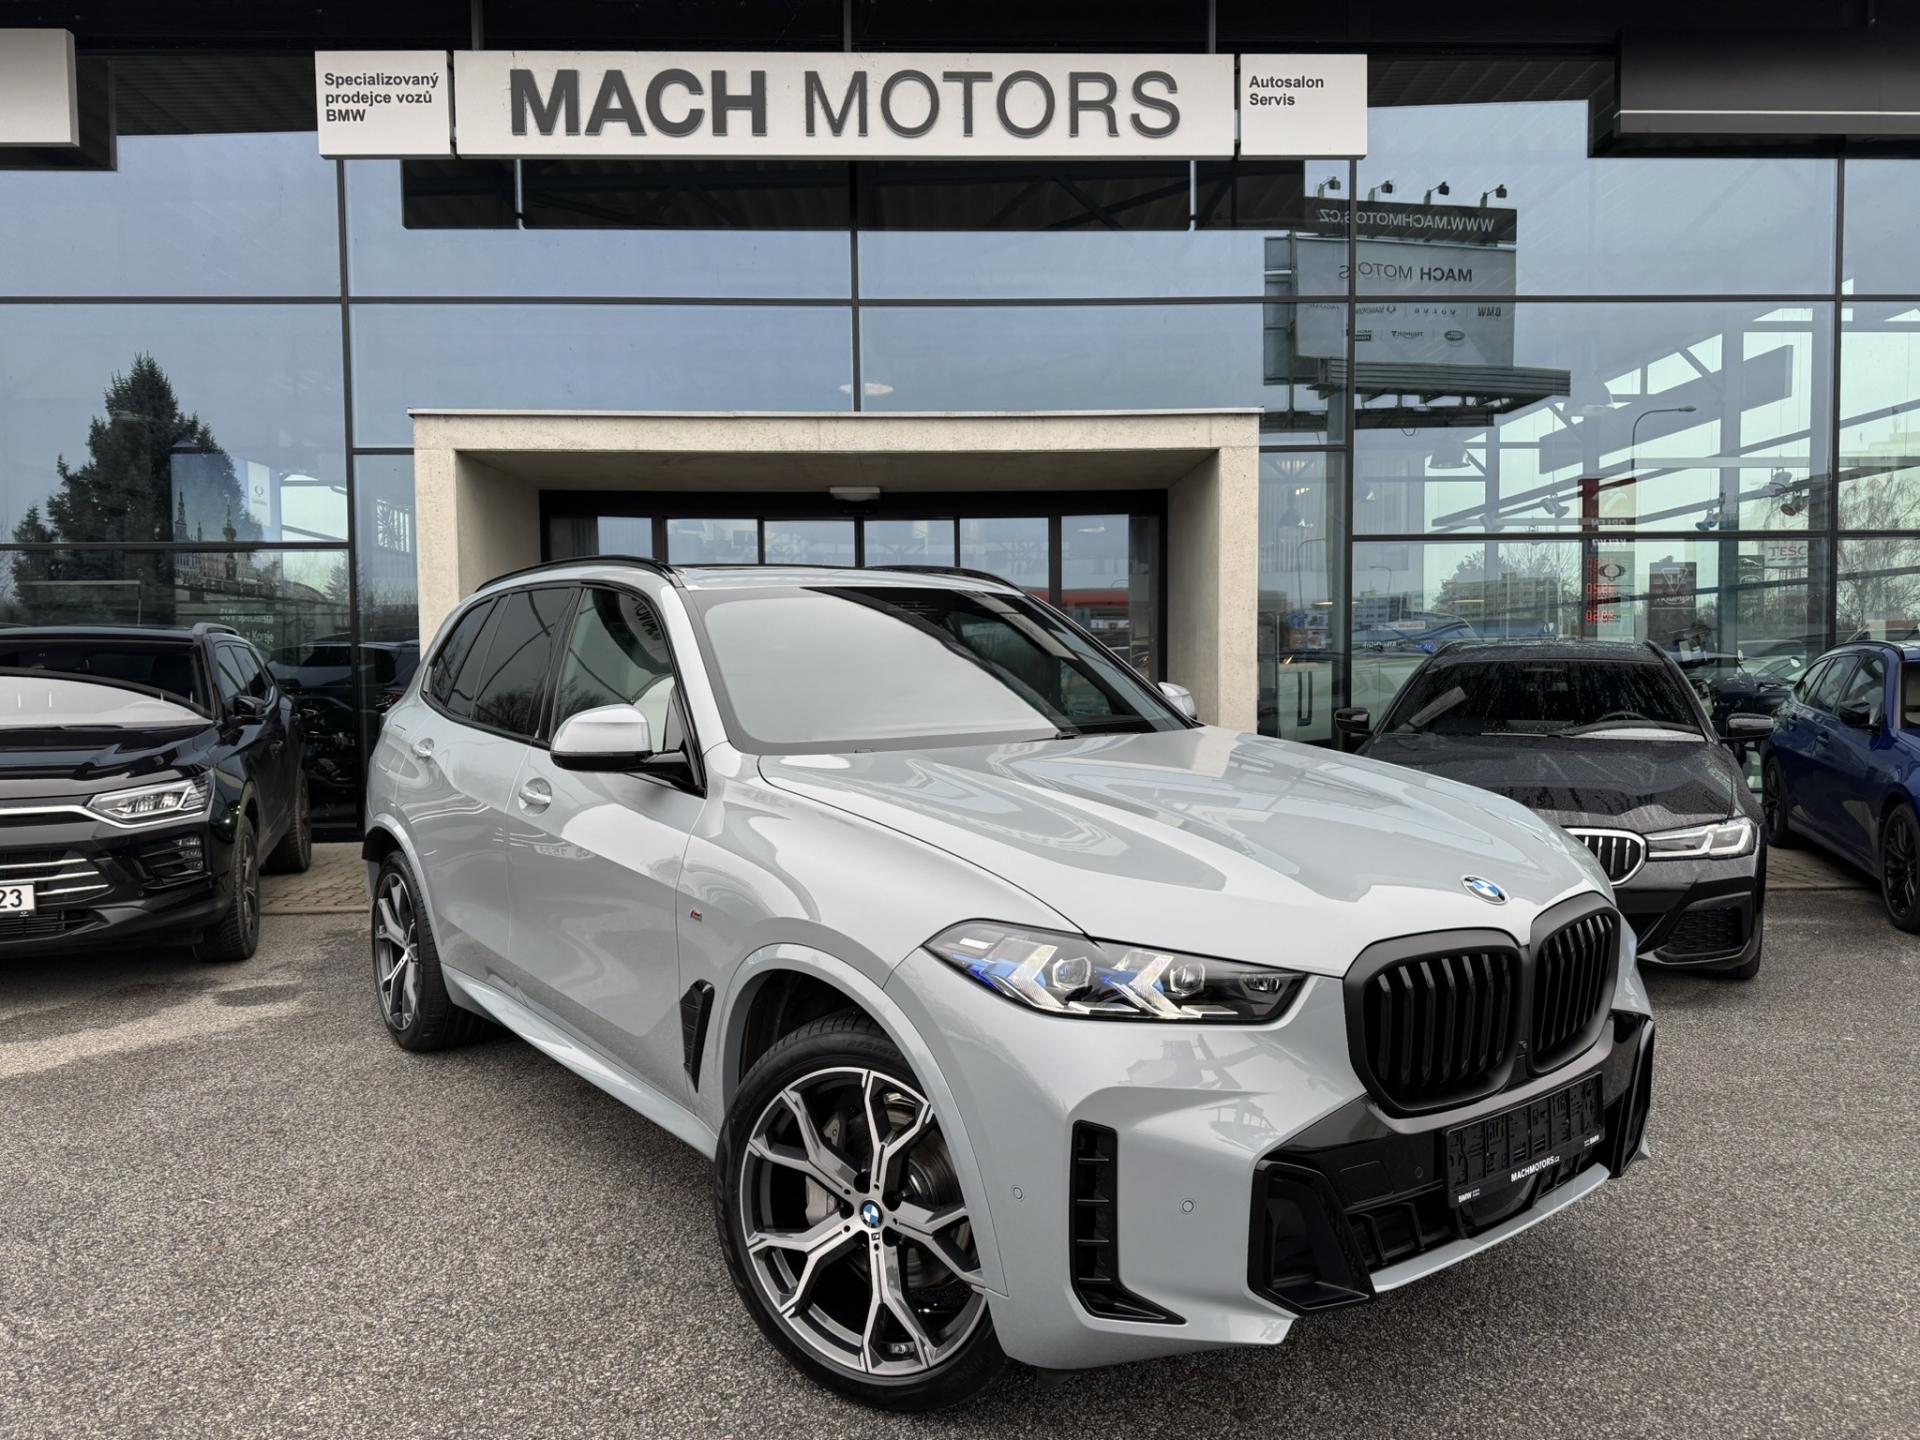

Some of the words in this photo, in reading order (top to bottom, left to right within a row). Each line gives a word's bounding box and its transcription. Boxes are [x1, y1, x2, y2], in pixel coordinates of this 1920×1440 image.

[324, 72, 439, 89] Specializovaný
[1249, 75, 1324, 88] Autosalon
[325, 91, 392, 107] prodejce
[396, 90, 432, 103] vozů
[509, 68, 768, 137] MACH
[804, 69, 1181, 138] MOTORS
[1249, 93, 1295, 106] Servis
[326, 109, 366, 122] BMW
[1767, 545, 1808, 557] TESC
[0, 888, 22, 909] 23
